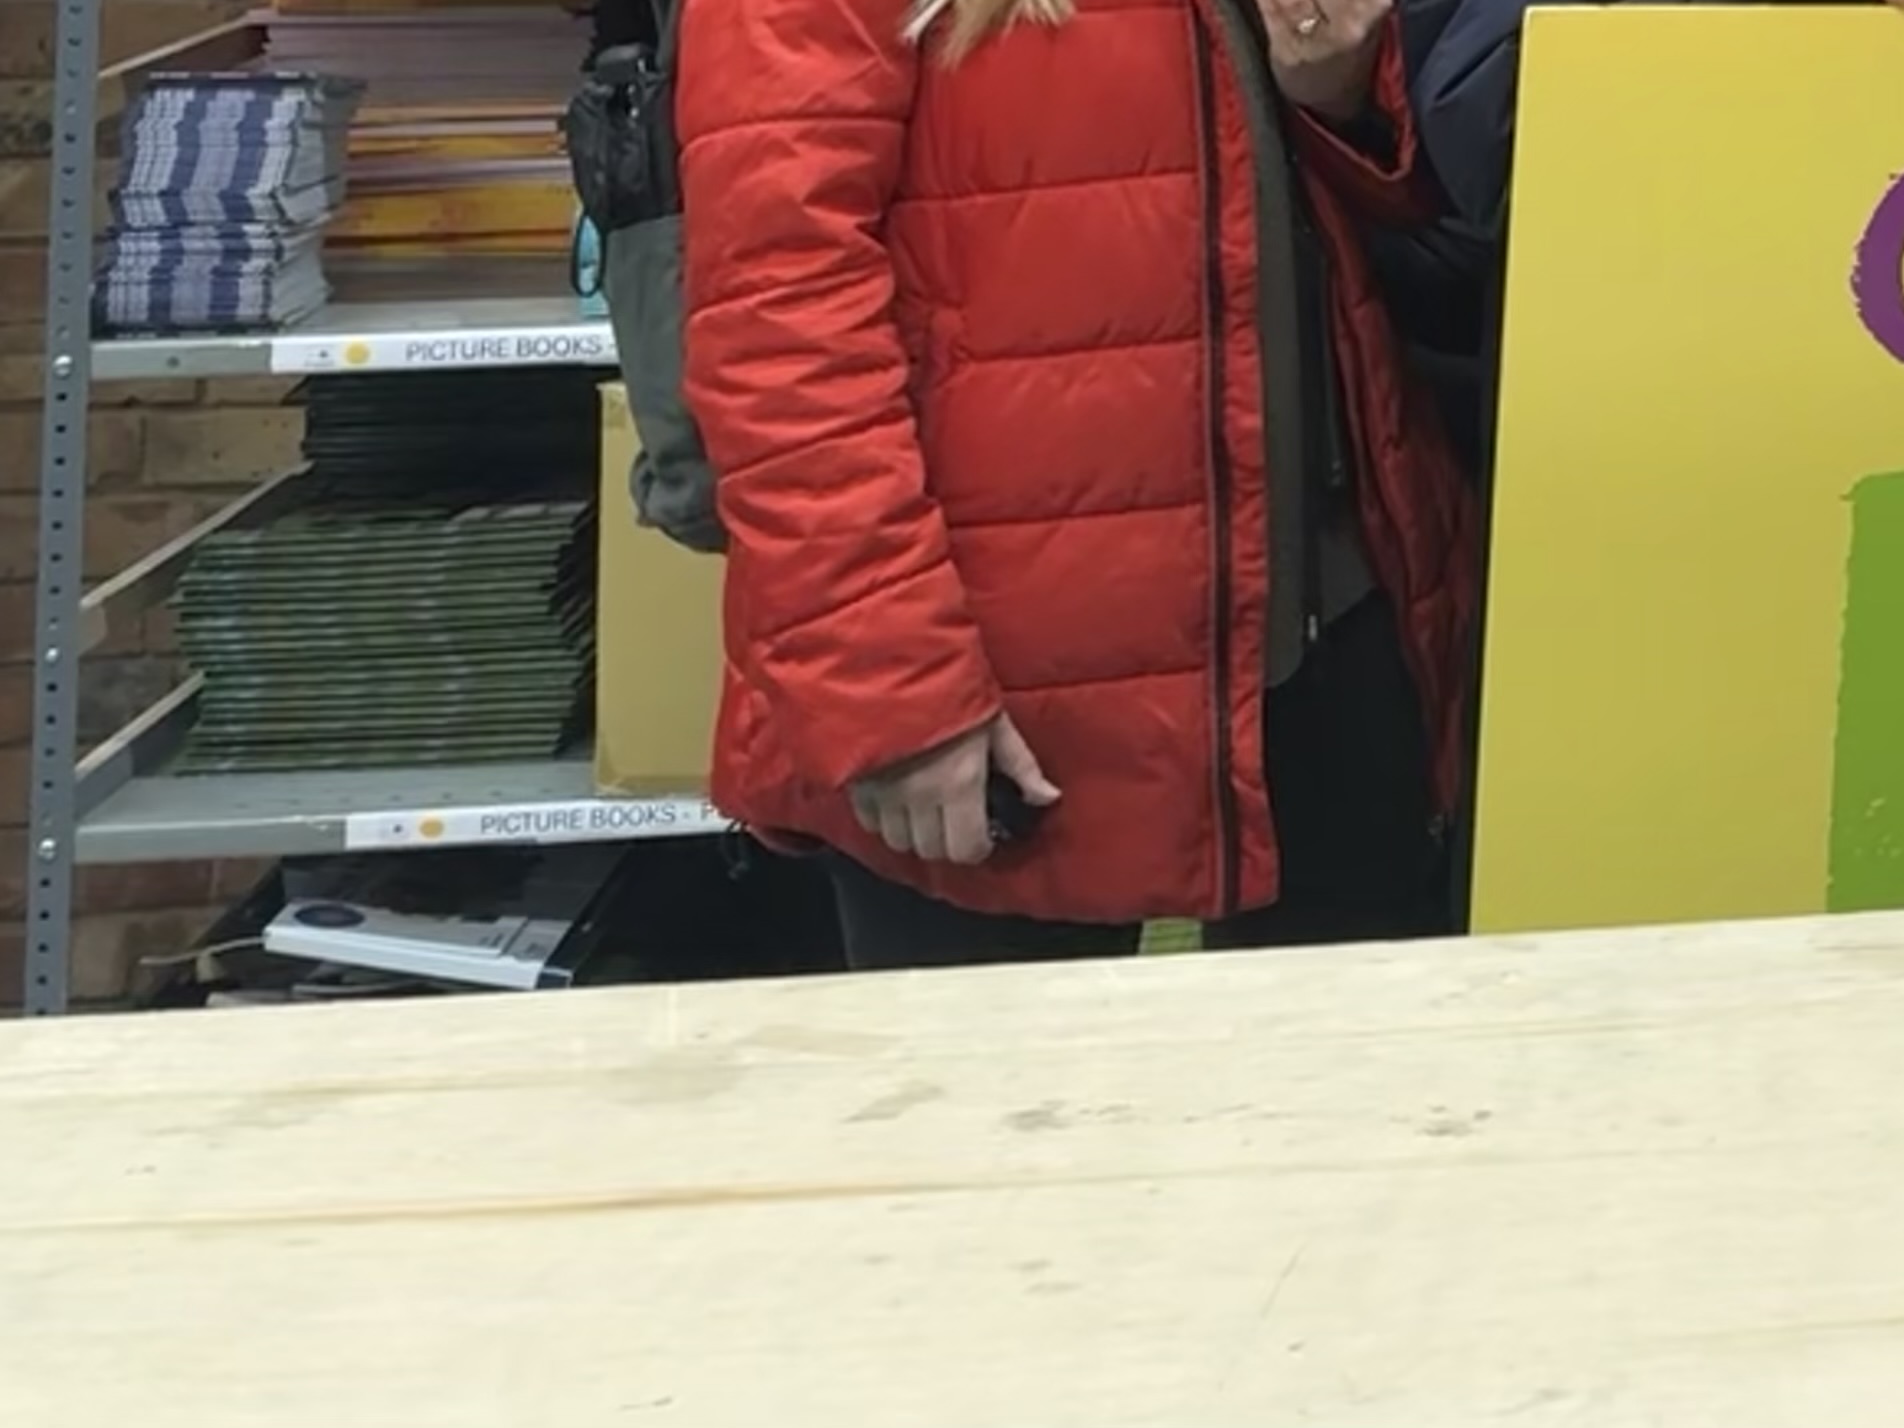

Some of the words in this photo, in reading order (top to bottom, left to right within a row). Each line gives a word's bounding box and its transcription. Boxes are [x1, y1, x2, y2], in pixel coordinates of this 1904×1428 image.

[404, 336, 509, 363] PICTURE
[516, 334, 603, 358] BOOKS
[480, 808, 584, 835] PICTURE
[591, 803, 677, 829] BOOKS
